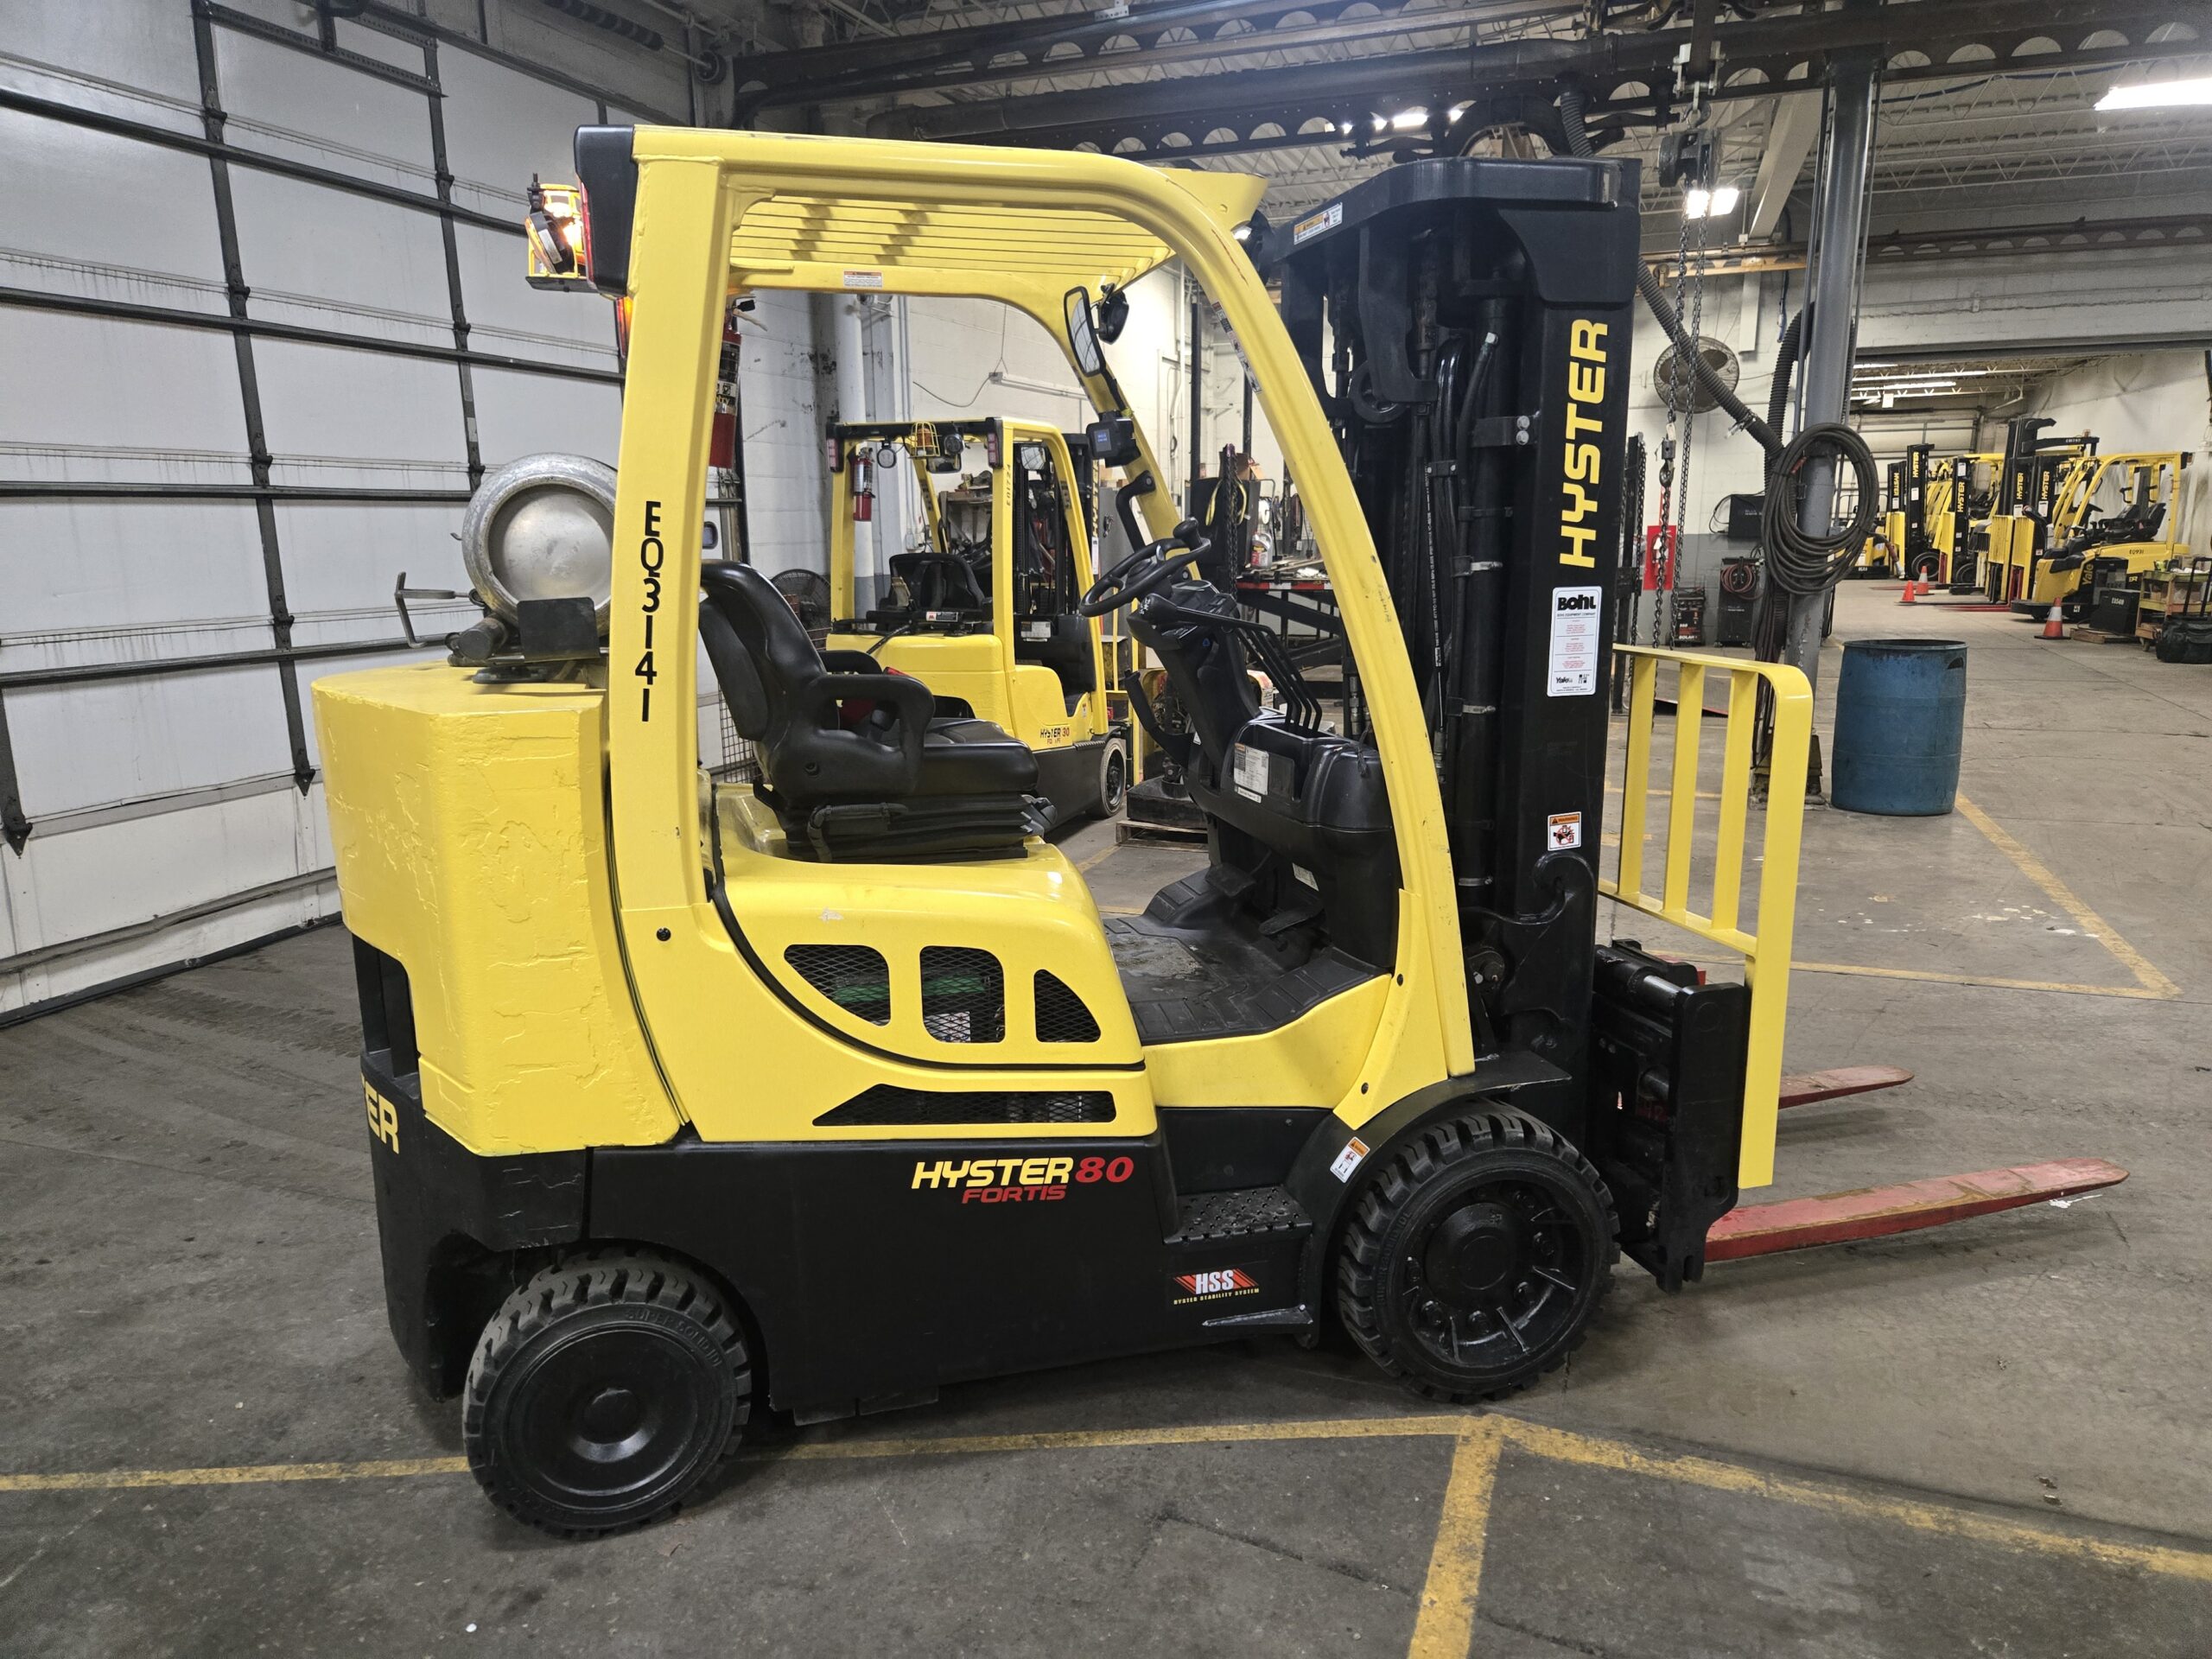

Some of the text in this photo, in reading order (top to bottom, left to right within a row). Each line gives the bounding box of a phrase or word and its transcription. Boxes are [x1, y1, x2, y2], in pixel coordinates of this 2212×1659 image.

[1559, 319, 1608, 569] HYSTER
[1957, 481, 1966, 512] HYSTER
[2016, 472, 2024, 499] HYSTER
[2041, 470, 2050, 499] HYSTER
[2082, 563, 2094, 585] Yale
[911, 1156, 1135, 1189] HYSTER 80
[962, 1185, 1067, 1205] FORTIS
[1195, 1269, 1234, 1295] HSS
[1199, 1292, 1232, 1301] STABILITY
[1235, 1287, 1260, 1296] SYSTEM
